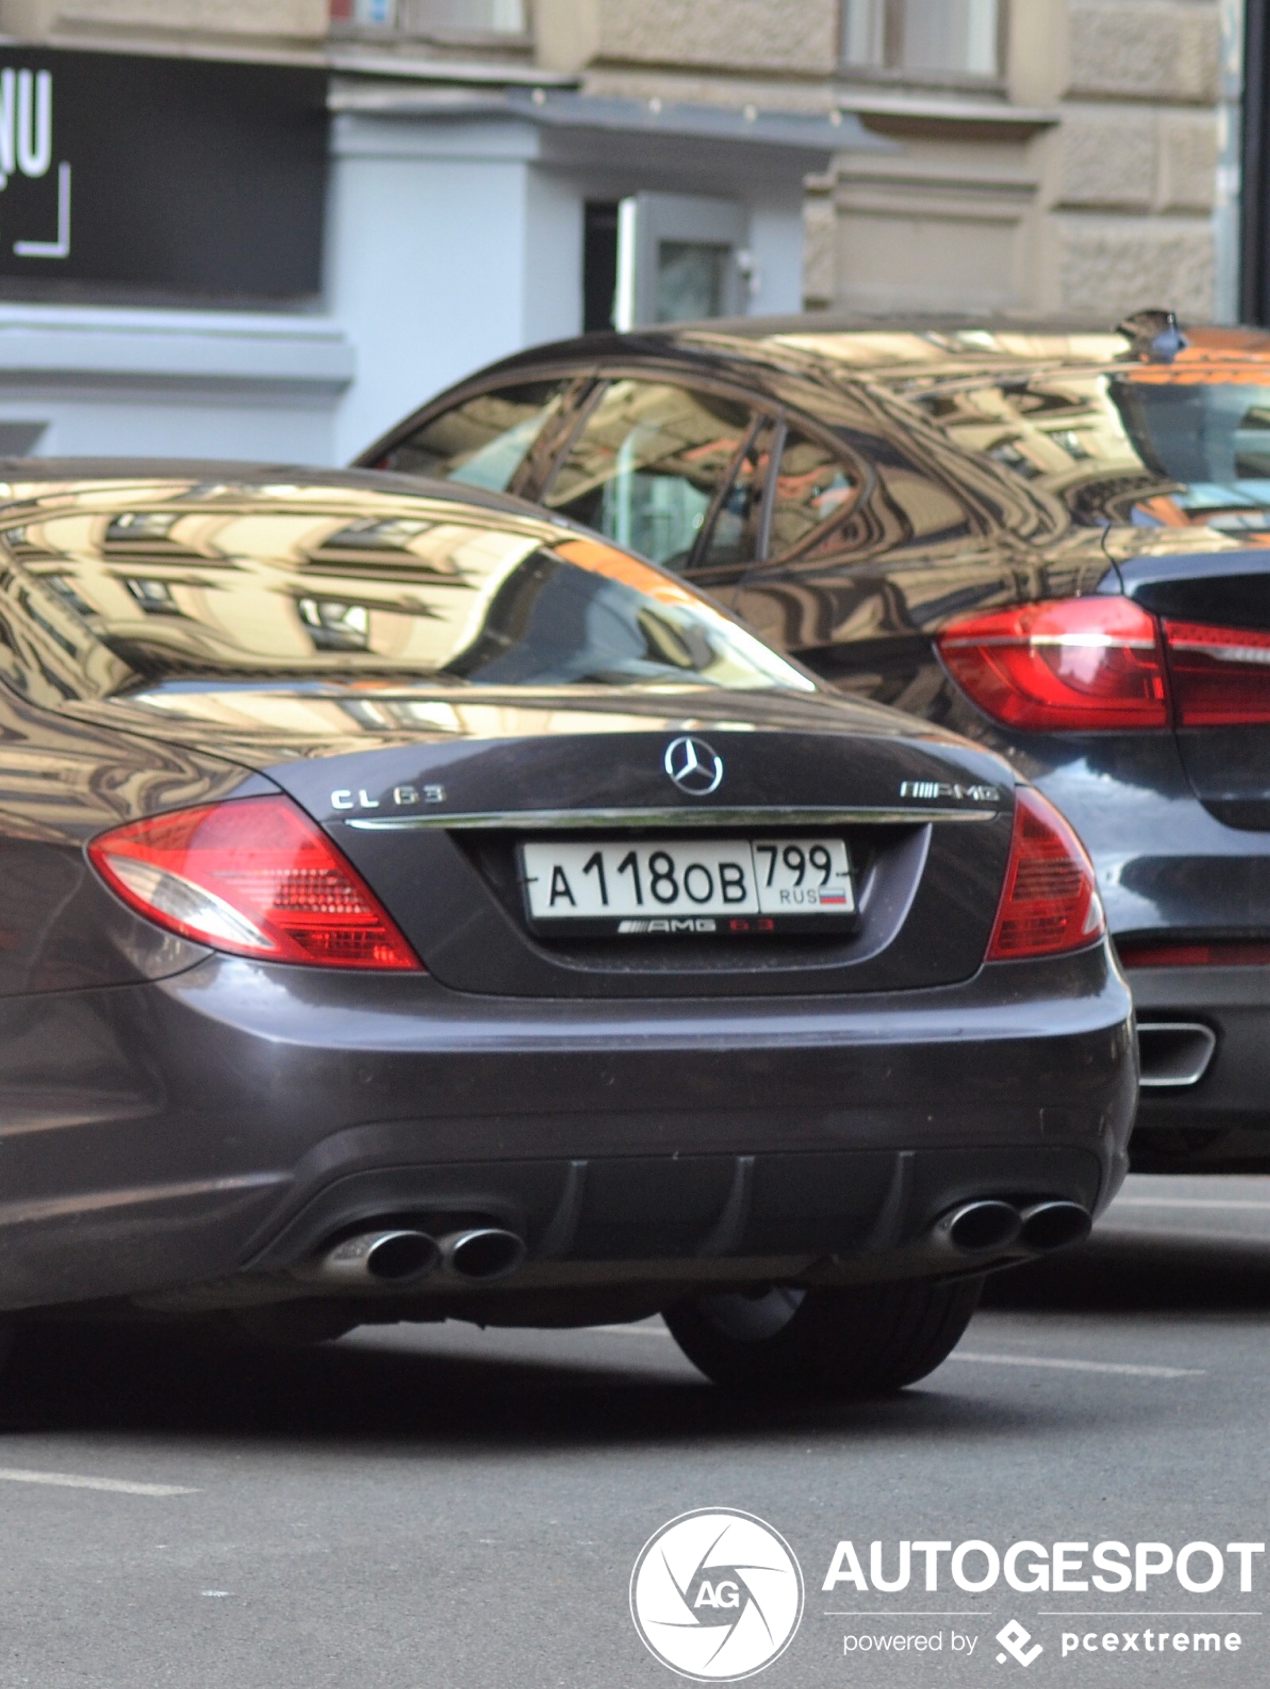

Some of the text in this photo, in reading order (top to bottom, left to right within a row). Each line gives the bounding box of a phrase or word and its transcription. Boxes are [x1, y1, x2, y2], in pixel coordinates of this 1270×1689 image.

[331, 784, 447, 809] CL 63
[756, 845, 831, 888] 799
[780, 889, 817, 904] RUS
